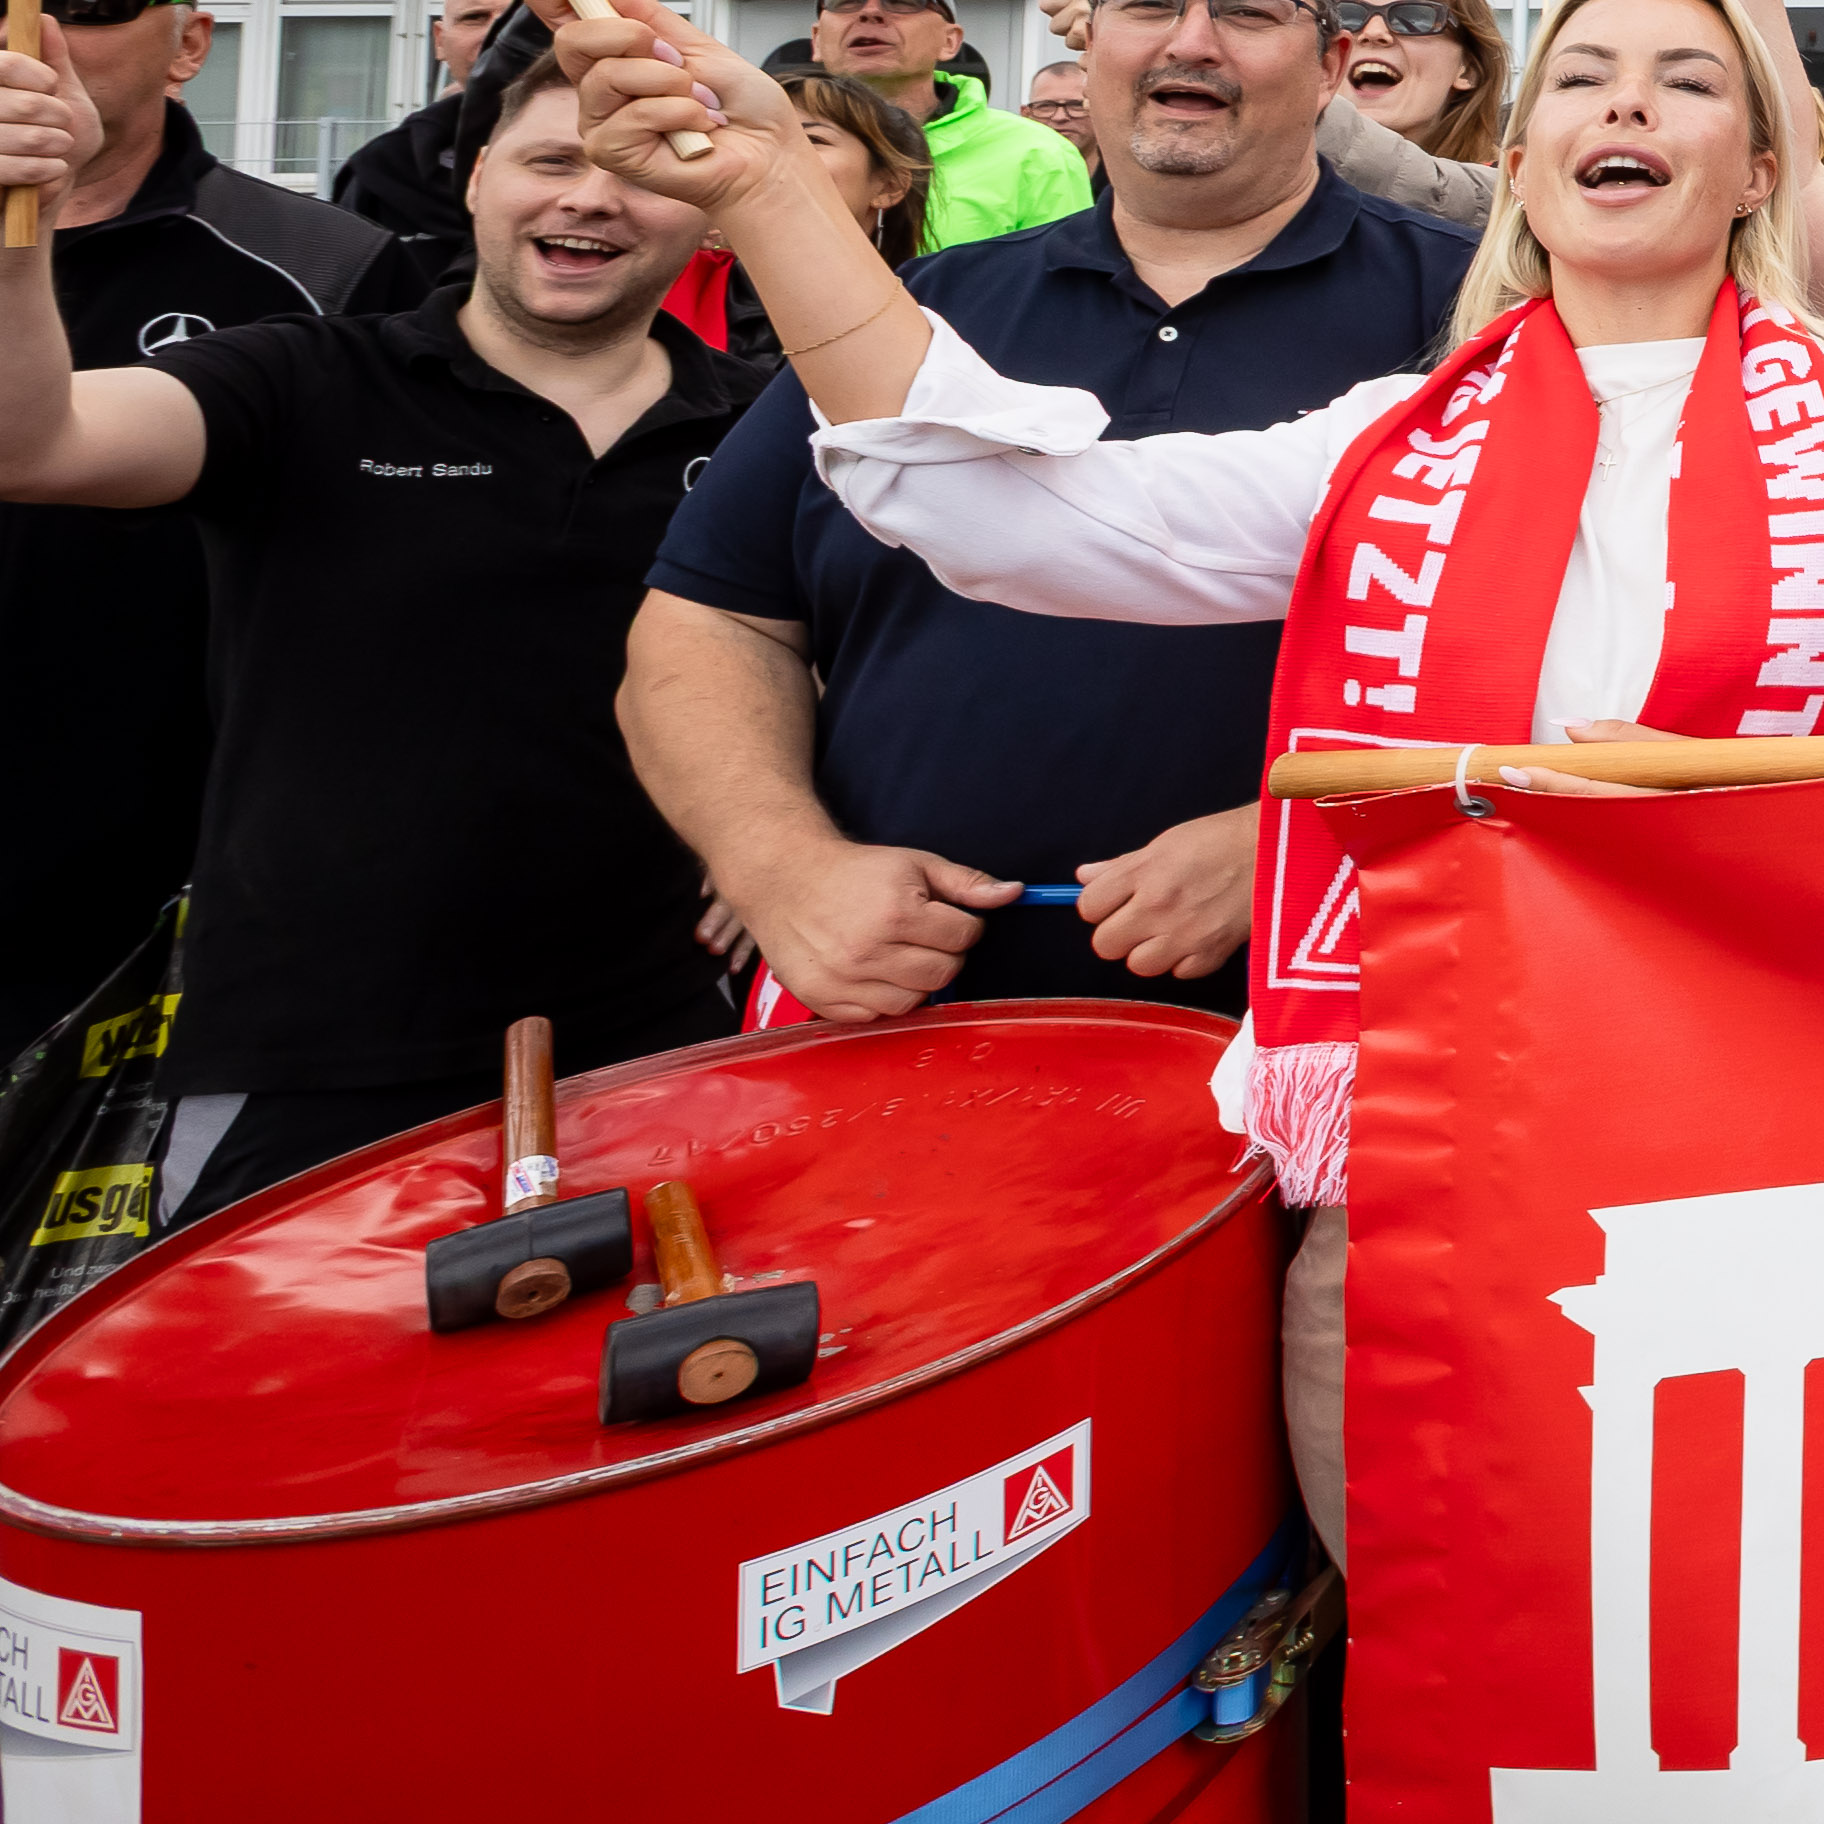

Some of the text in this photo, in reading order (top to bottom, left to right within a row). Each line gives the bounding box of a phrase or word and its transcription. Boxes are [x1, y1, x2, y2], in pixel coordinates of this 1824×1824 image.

[359, 459, 494, 477] Robert Sandu
[1342, 419, 1491, 715] JETZT!
[760, 1529, 994, 1649] IG METALL
[761, 1501, 958, 1607] EINFACH
